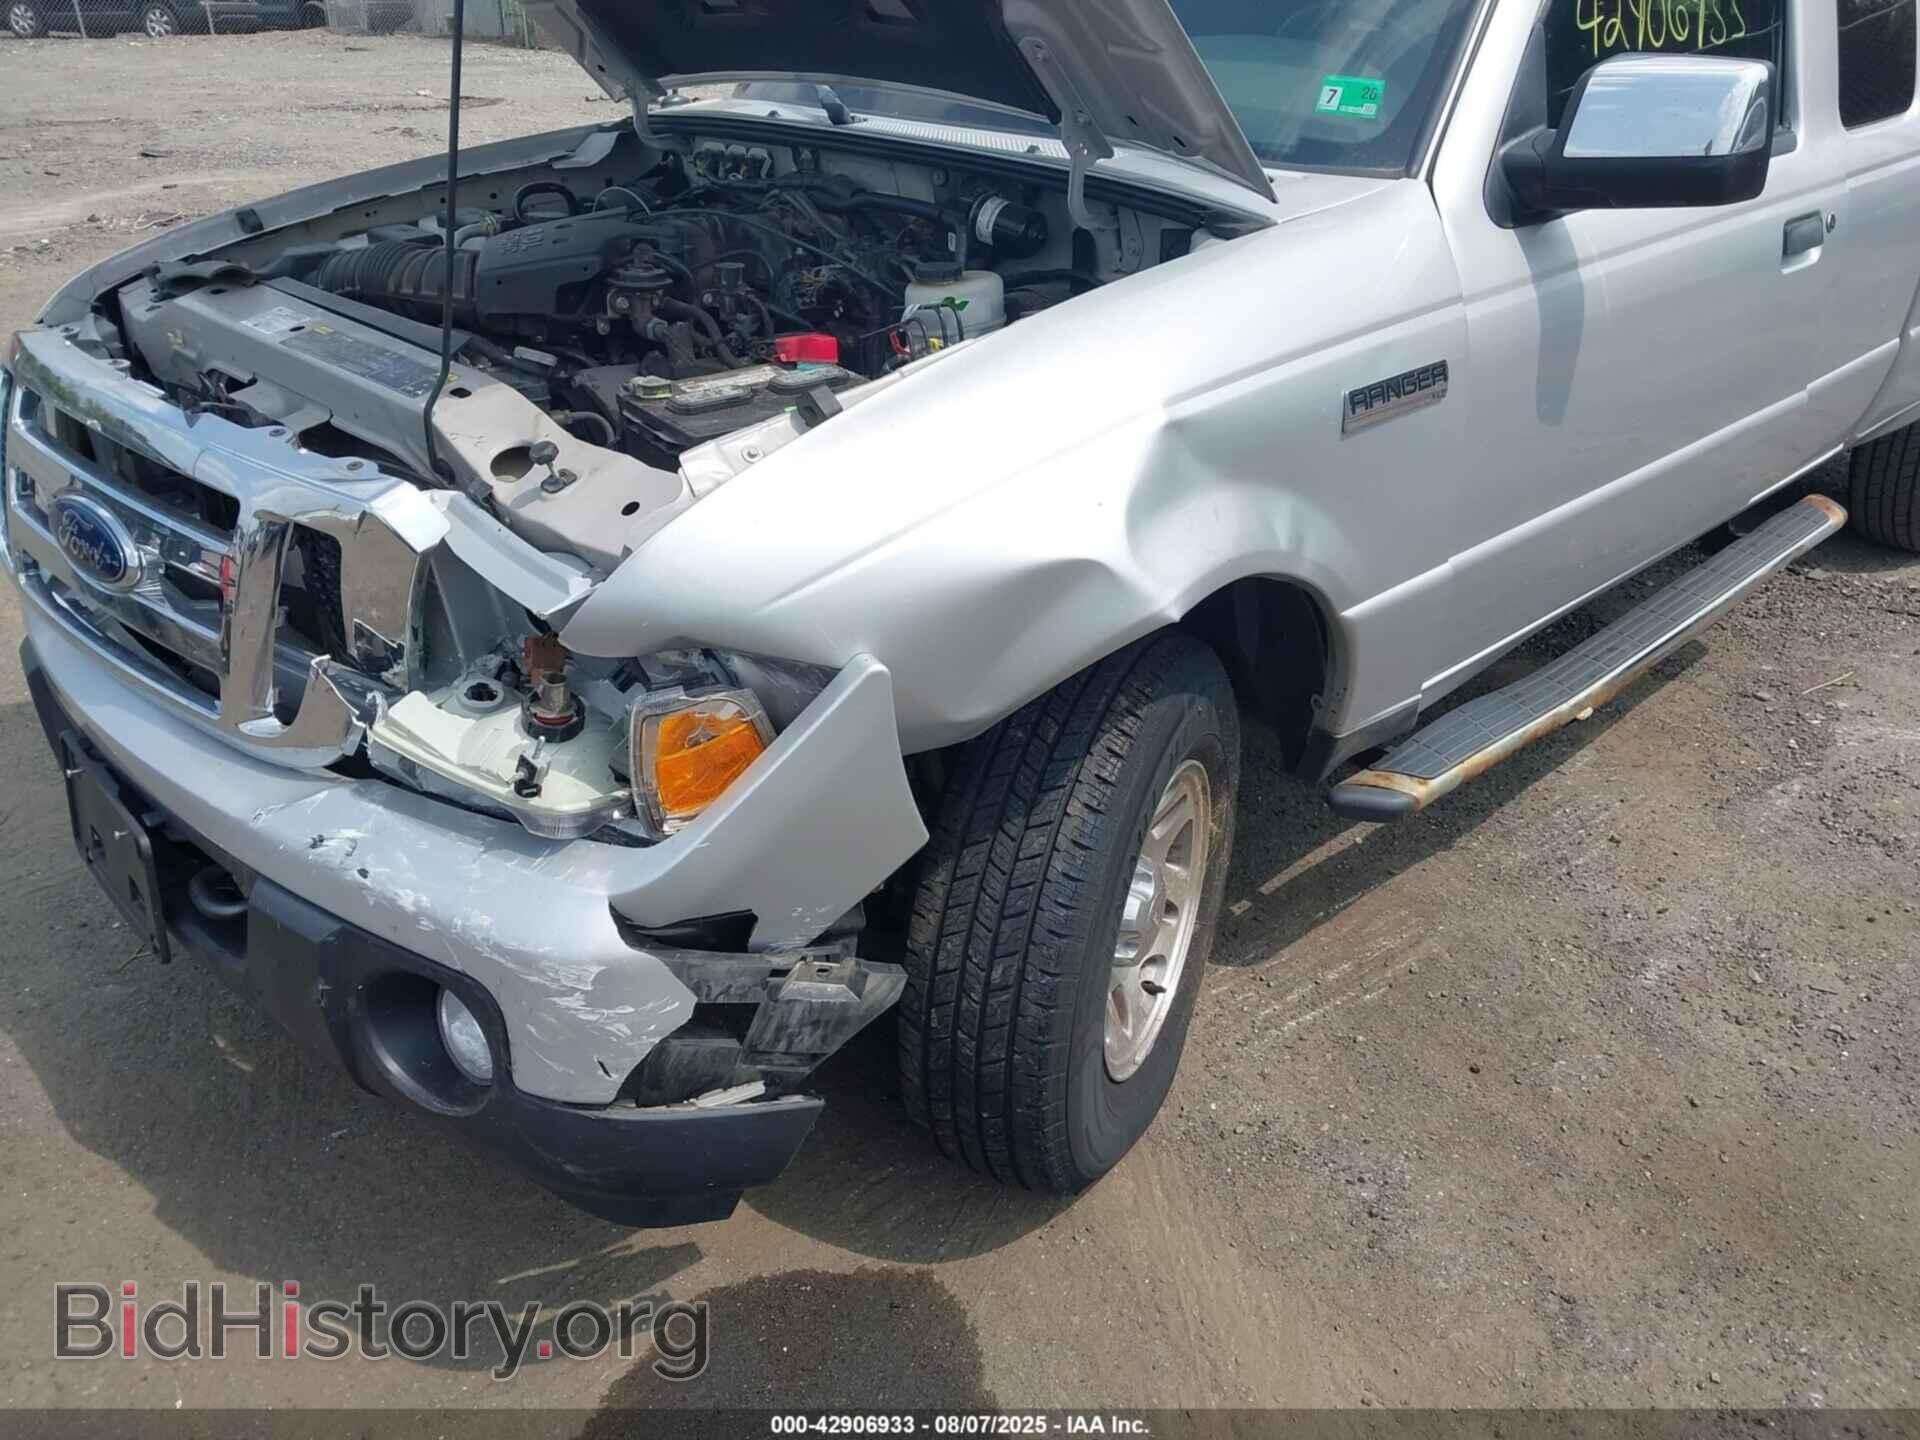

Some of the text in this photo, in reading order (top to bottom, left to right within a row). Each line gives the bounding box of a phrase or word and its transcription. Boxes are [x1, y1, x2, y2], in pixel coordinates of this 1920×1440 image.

[1326, 88, 1339, 105] 7
[1348, 366, 1448, 415] RANGER
[58, 508, 121, 570] Ford
